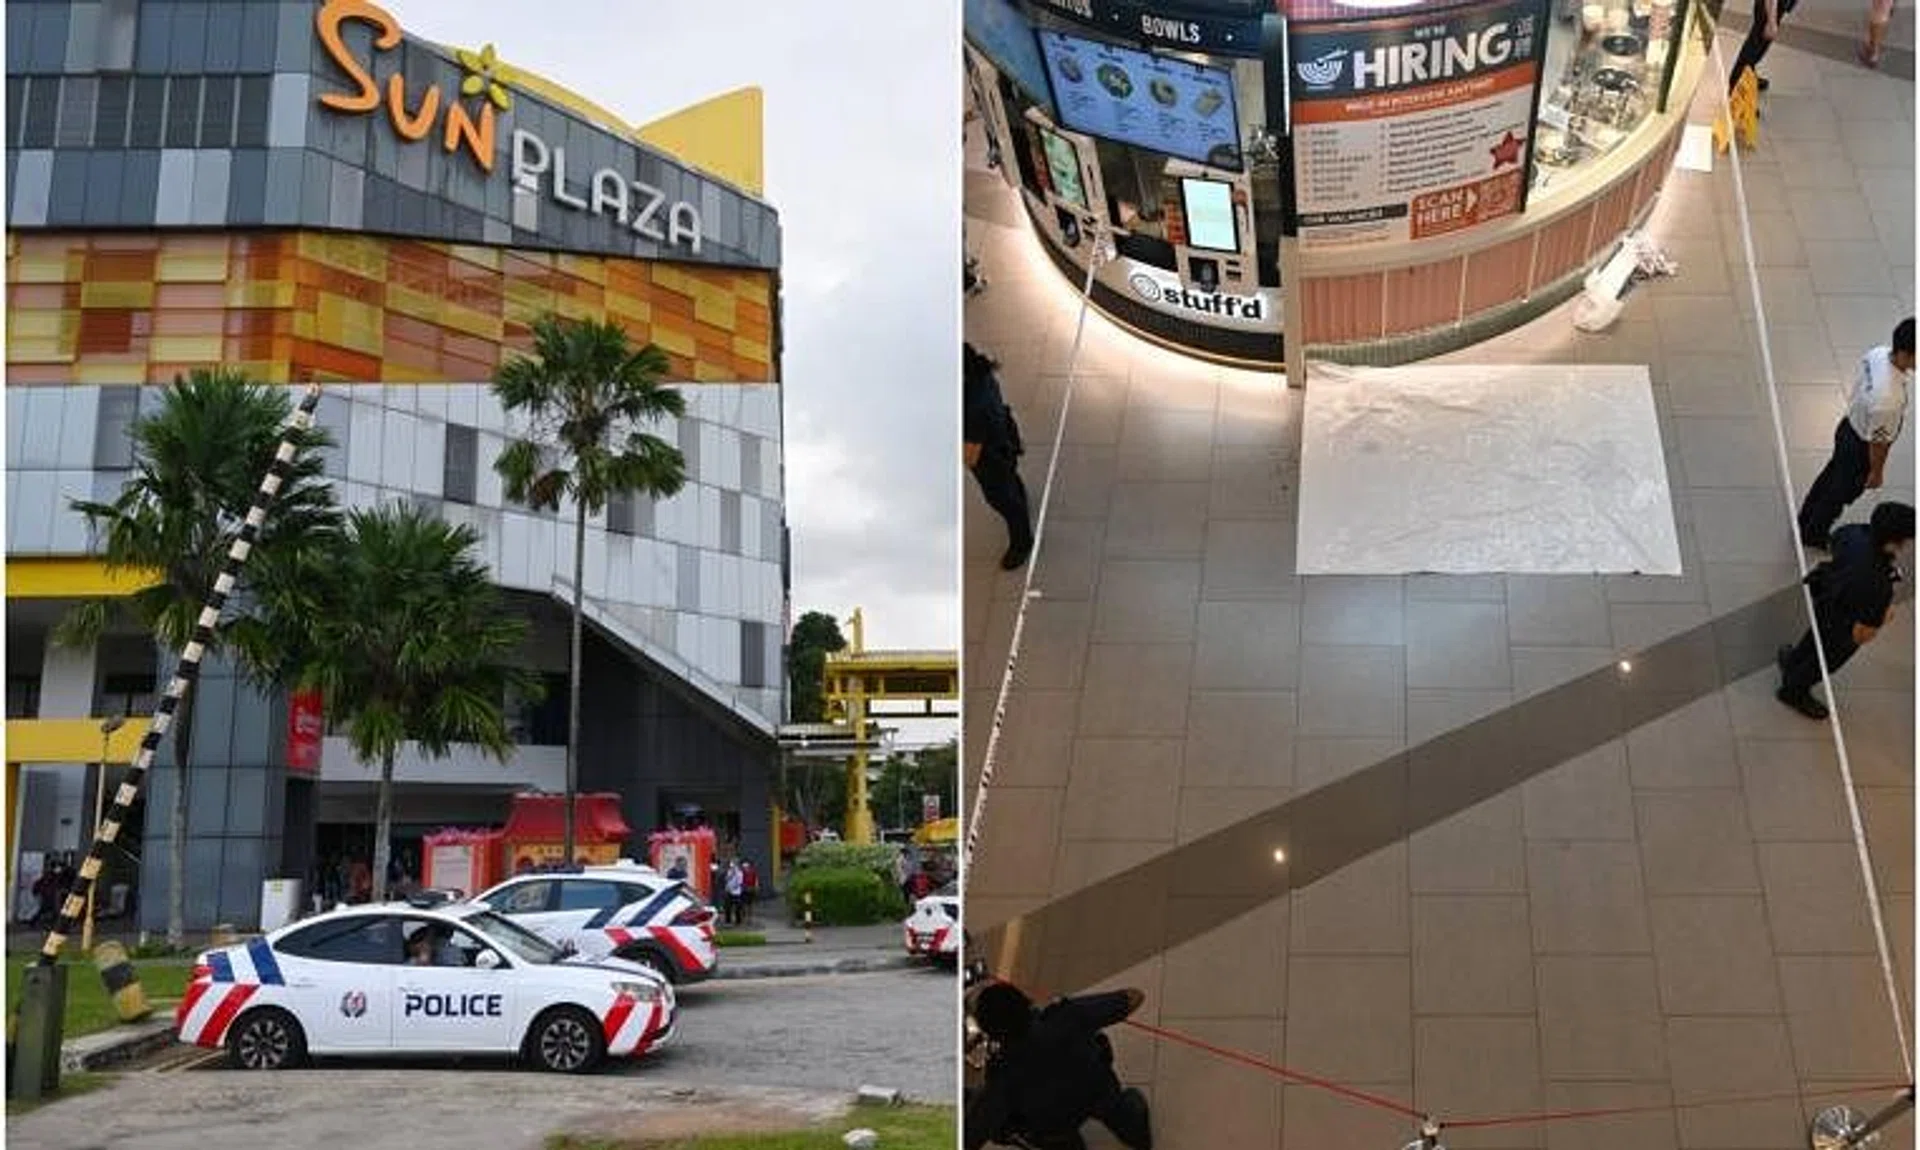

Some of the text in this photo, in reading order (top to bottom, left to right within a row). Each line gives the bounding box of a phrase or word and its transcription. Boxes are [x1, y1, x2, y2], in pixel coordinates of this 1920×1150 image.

[1142, 14, 1200, 43] BOWLS
[1353, 22, 1512, 90] HIRING
[513, 129, 701, 254] PLAZA
[1164, 288, 1262, 320] stuff'd
[405, 994, 503, 1017] POLICE
